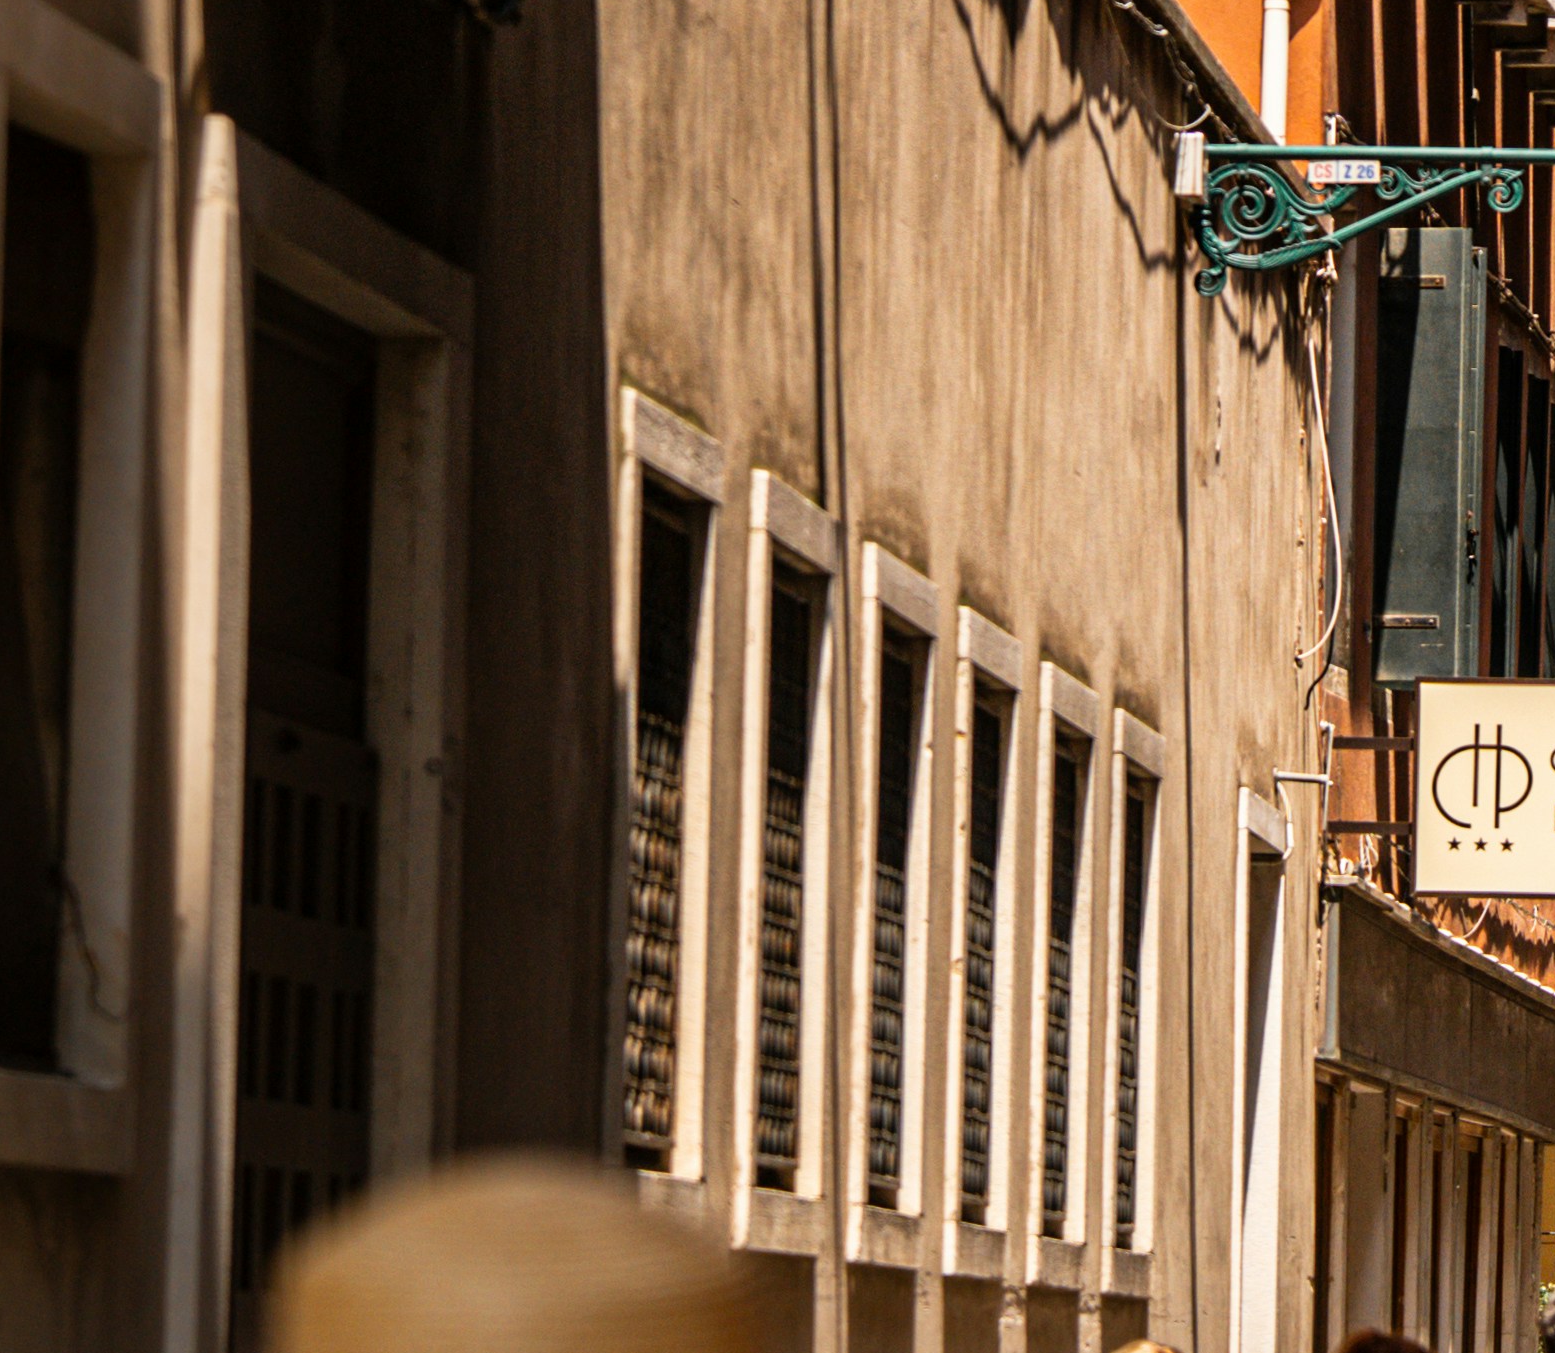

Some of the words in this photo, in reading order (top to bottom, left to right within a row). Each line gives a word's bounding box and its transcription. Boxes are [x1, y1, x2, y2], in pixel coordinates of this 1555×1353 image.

[1314, 163, 1333, 178] CS
[1344, 164, 1352, 179] Z
[1357, 164, 1375, 179] 26
